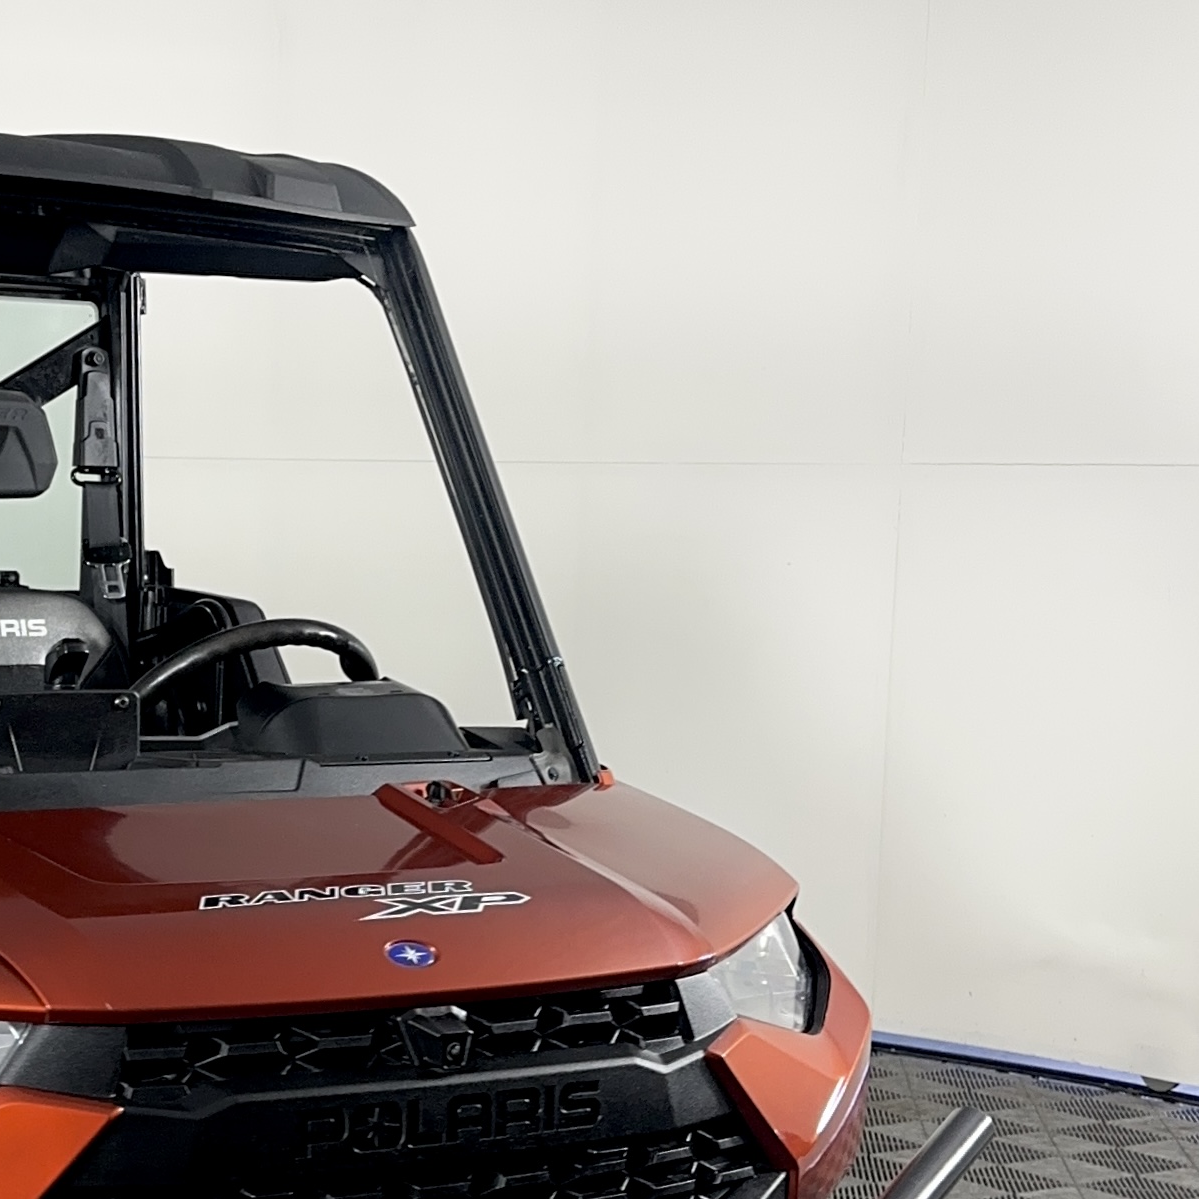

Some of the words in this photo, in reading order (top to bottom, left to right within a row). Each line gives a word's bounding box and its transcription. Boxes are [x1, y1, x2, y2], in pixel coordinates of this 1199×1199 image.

[198, 879, 473, 911] RANGER
[356, 891, 532, 922] XP
[302, 1079, 601, 1157] POLARIS
